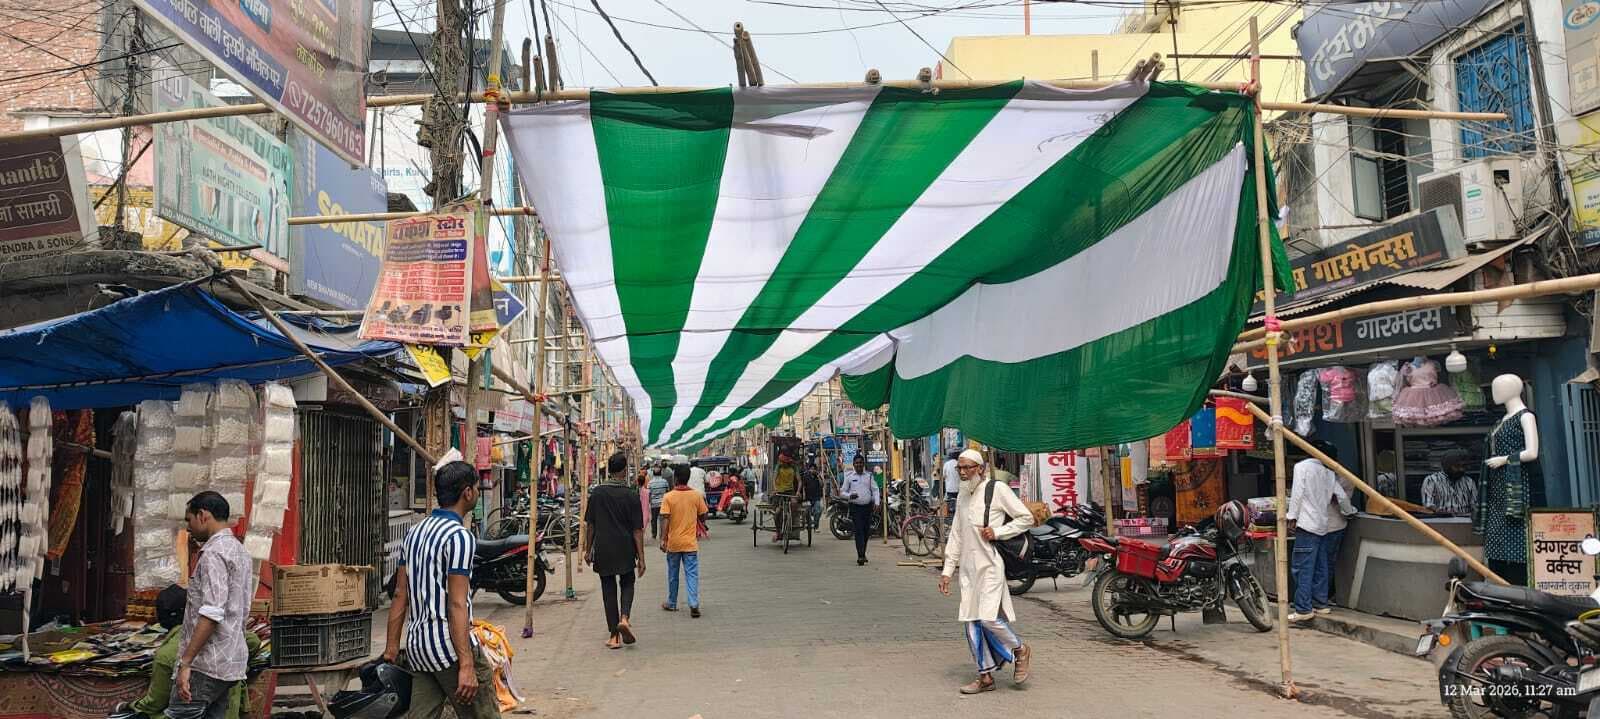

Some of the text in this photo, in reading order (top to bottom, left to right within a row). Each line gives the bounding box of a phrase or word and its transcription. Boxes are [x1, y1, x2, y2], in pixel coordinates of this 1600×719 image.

[301, 88, 363, 160] 7257960163
[15, 193, 62, 220] सामग्री
[317, 190, 384, 259] SONATA
[0, 235, 76, 255] ENDRA & SONS
